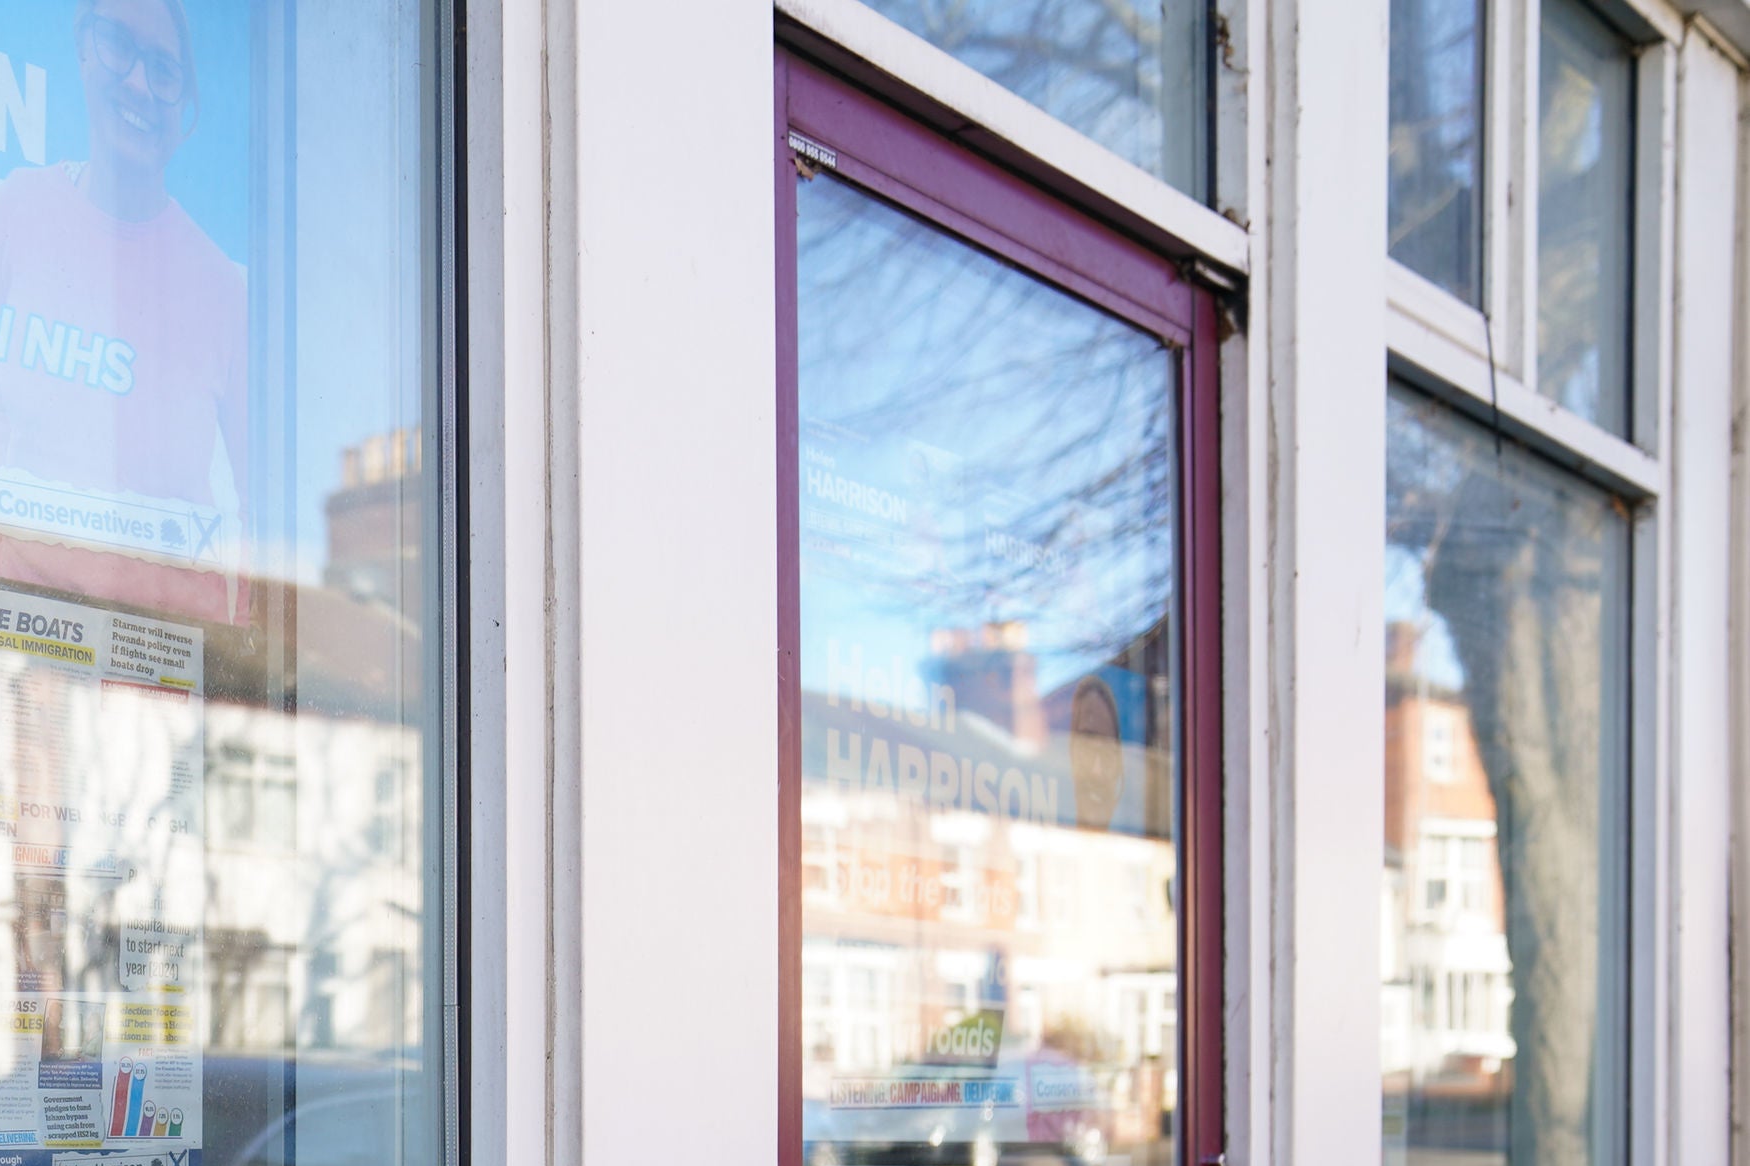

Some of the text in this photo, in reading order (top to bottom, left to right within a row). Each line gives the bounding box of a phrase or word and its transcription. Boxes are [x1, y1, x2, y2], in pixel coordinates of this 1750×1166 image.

[20, 312, 136, 395] NHS
[807, 466, 906, 525] HARRISON
[16, 612, 84, 643] BOATS
[21, 639, 92, 662] IMMIGRATION
[827, 640, 956, 735] Helen
[826, 727, 1059, 825] HARRISON
[926, 1019, 994, 1057] roads
[890, 1082, 962, 1103] CAMPAIGNING.
